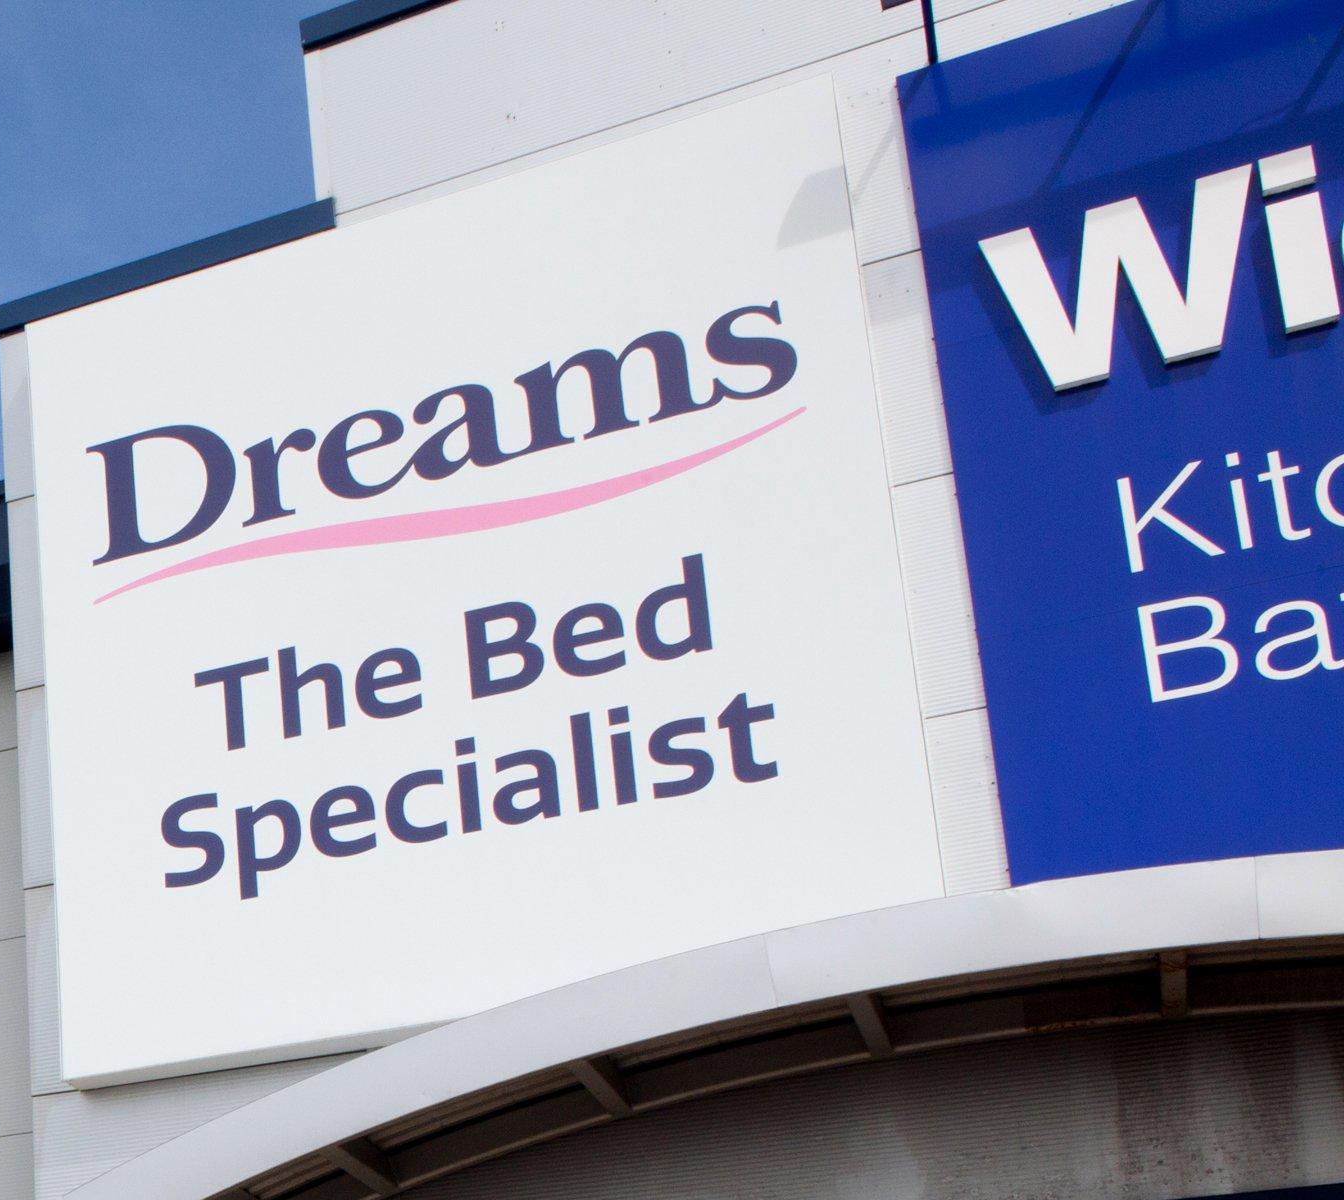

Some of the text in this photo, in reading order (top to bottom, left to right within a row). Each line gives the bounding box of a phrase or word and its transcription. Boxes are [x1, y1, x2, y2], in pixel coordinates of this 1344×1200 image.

[978, 145, 1344, 392] Wi
[86, 299, 799, 567] Dreams
[193, 552, 714, 752] The Bed
[1137, 593, 1344, 704] Ba
[159, 692, 779, 900] Specialist
